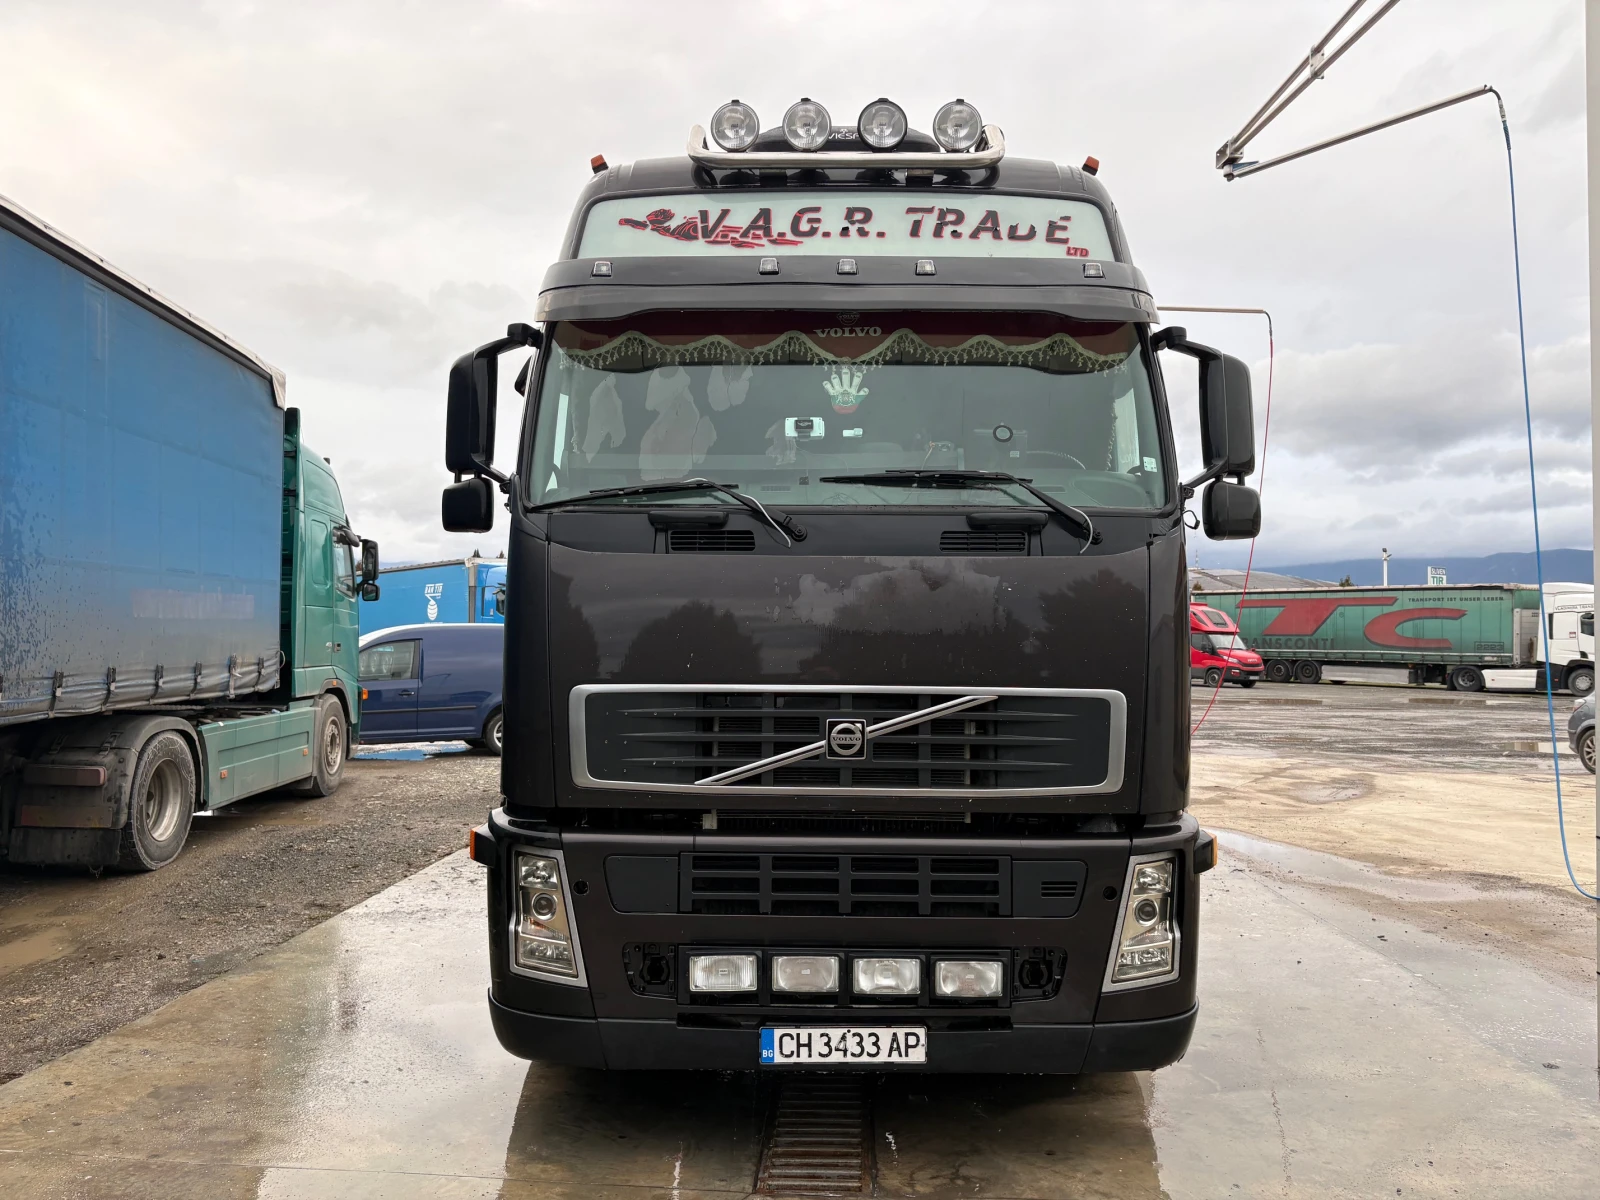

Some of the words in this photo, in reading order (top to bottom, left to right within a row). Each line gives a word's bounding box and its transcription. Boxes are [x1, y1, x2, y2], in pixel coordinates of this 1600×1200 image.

[904, 205, 1072, 245] TRADE
[1066, 246, 1089, 257] LTD
[813, 326, 882, 338] VOLVO
[1431, 576, 1444, 585] TIR
[1240, 637, 1335, 650] RANSCONTI
[778, 1032, 812, 1058] CH
[818, 1031, 881, 1058] 3433
[887, 1031, 921, 1058] AP
[762, 1049, 774, 1058] BG
